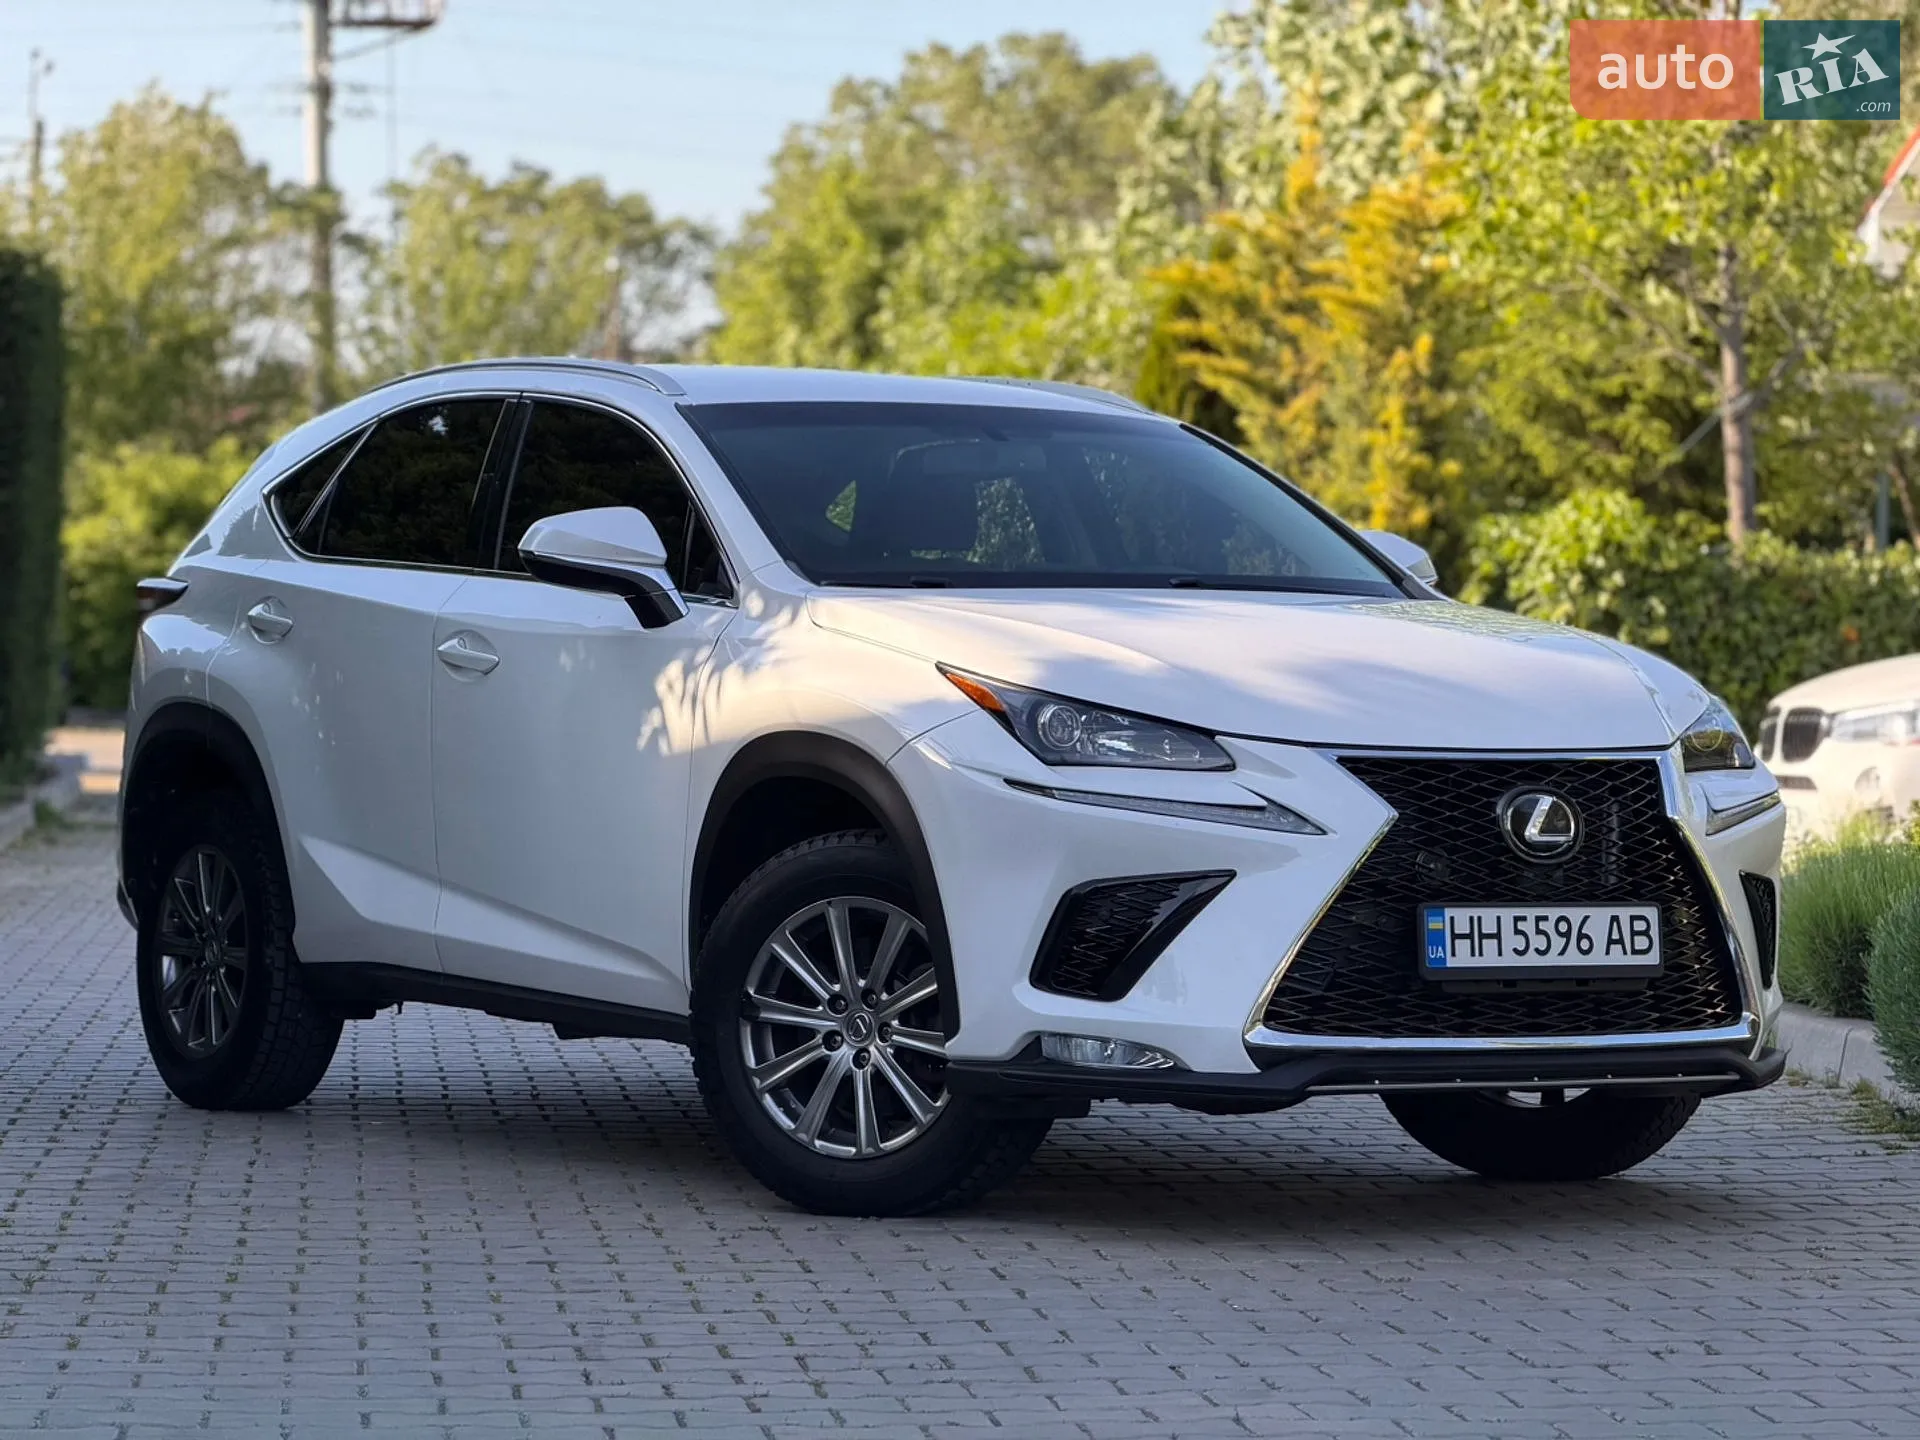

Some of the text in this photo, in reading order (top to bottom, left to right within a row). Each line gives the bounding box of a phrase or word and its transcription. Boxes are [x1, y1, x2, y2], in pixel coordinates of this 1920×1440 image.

[1450, 914, 1654, 957] HH 5596 AB
[1428, 946, 1445, 959] UA
